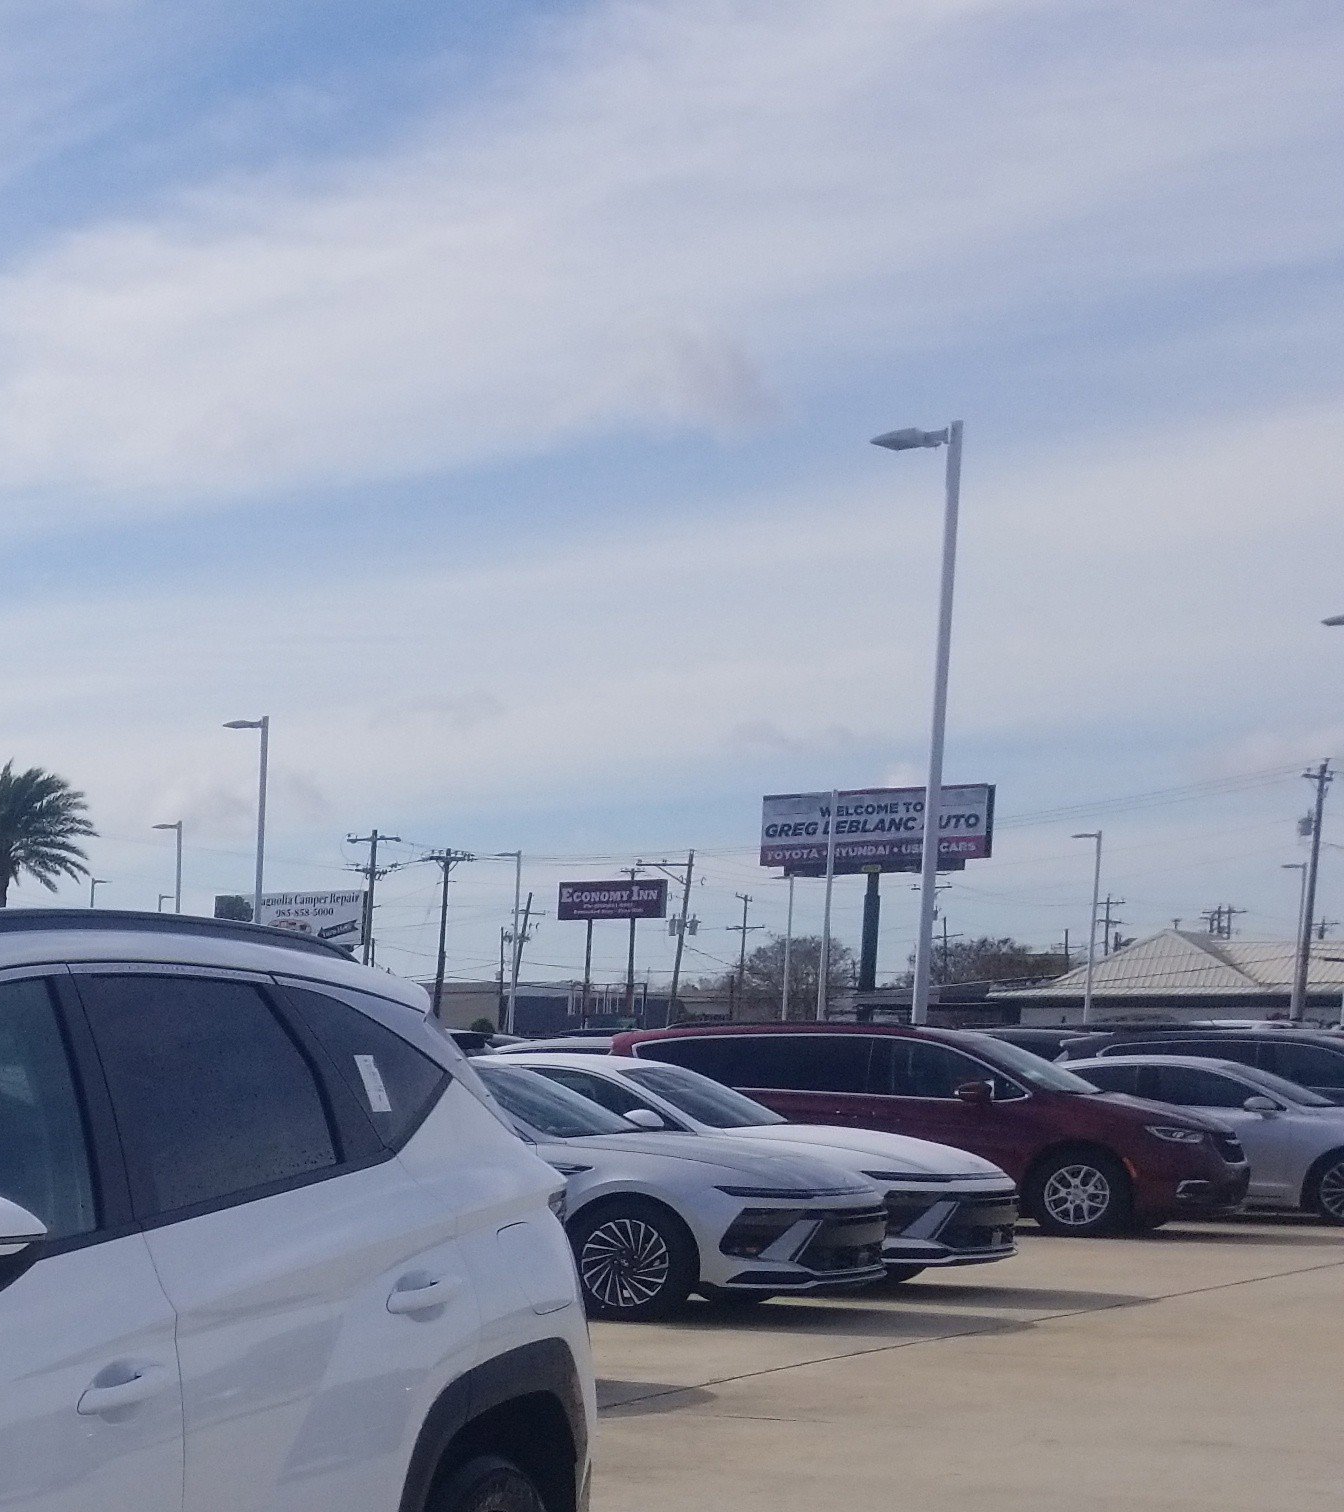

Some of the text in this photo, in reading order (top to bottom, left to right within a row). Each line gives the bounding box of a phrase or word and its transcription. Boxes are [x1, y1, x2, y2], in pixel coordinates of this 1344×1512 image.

[819, 802, 925, 818] WELCOME TO
[765, 821, 818, 838] GREG
[919, 813, 980, 830] UTO
[767, 848, 819, 860] TOYOTA
[261, 892, 359, 907] agnolia Camper Repair
[561, 886, 658, 902] ECONOMY INN
